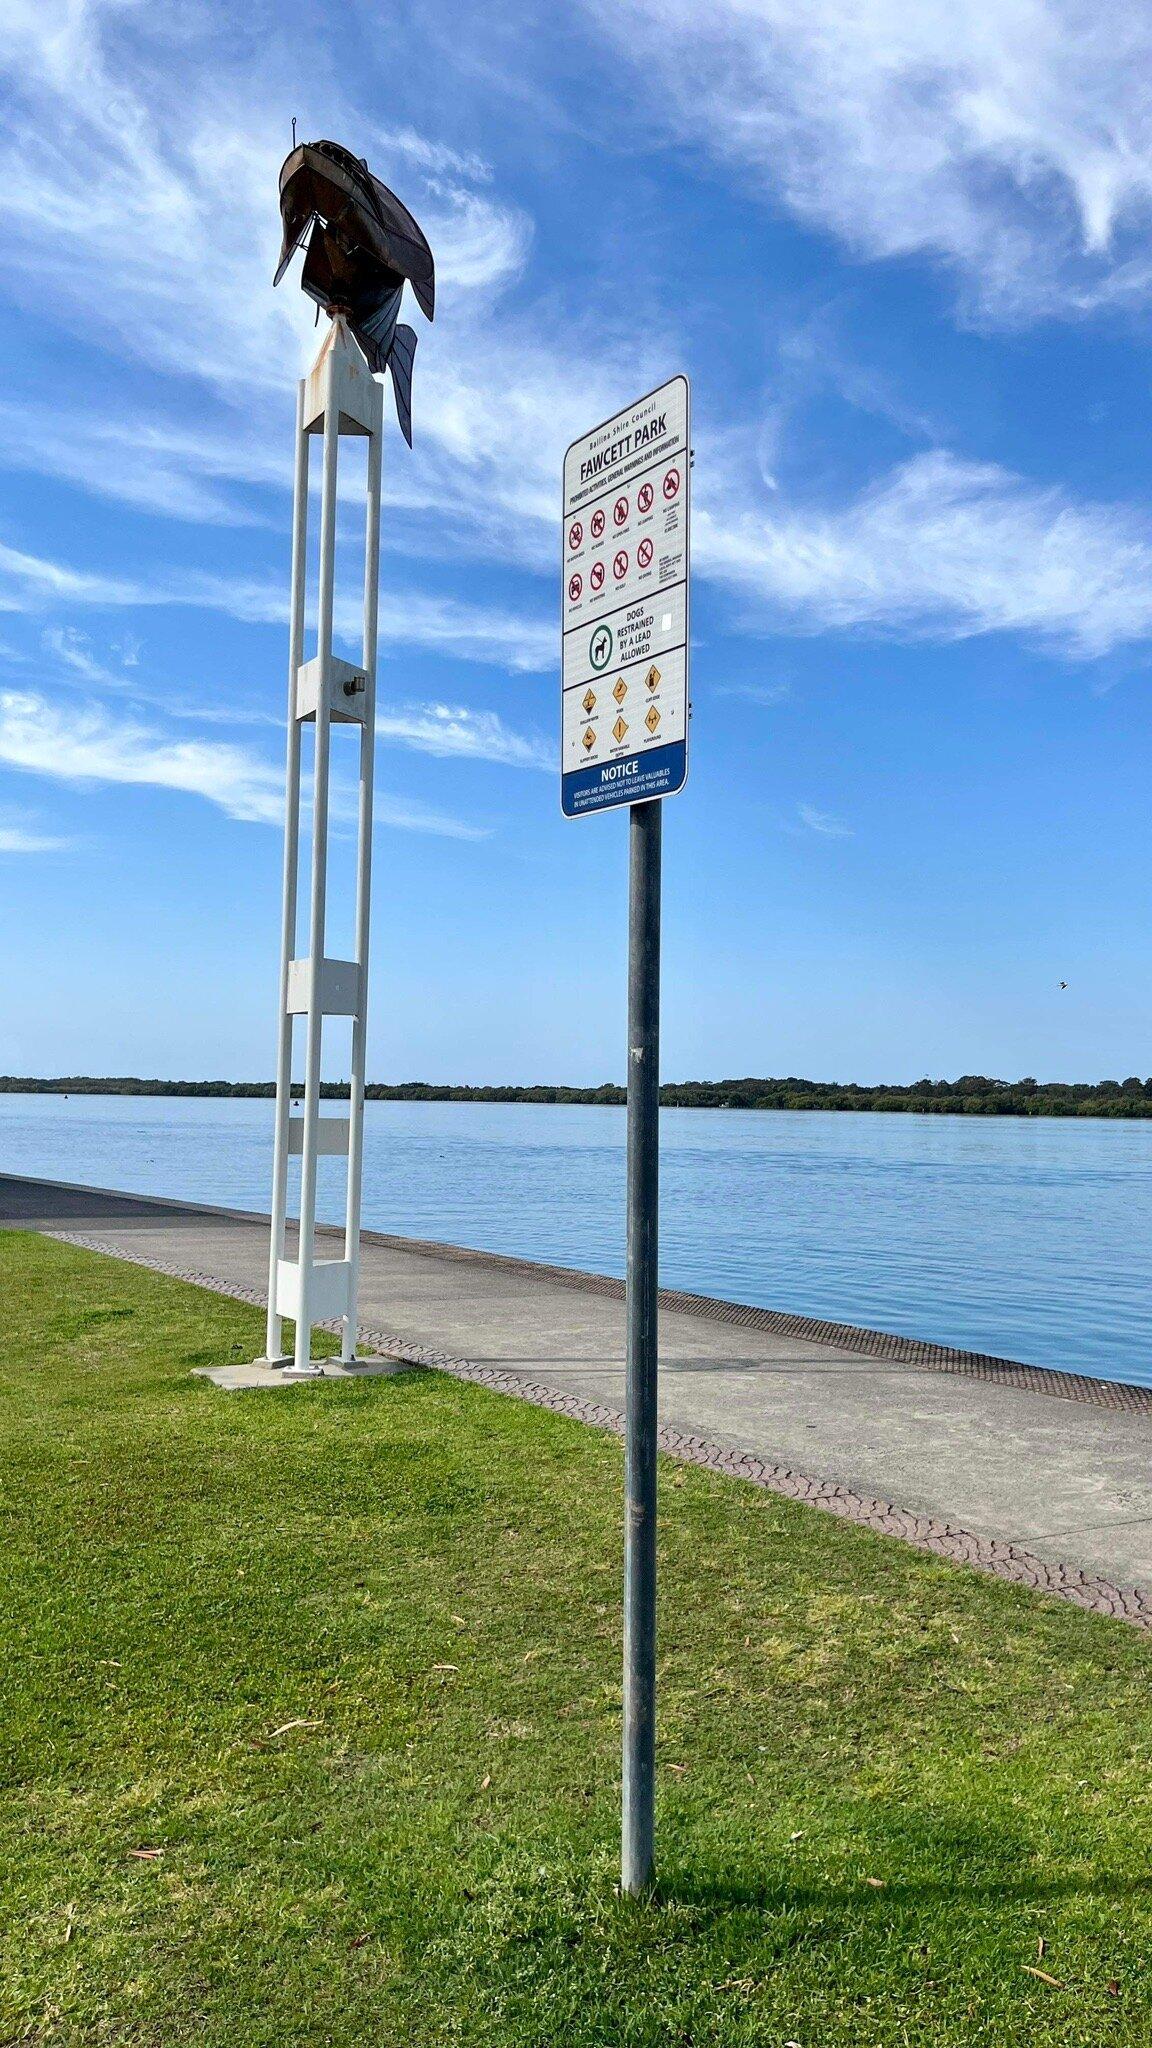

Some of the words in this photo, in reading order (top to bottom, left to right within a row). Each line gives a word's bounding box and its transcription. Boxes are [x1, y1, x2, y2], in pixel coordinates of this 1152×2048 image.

[589, 433, 611, 450] Ballina
[612, 421, 629, 436] Shire
[631, 401, 656, 423] Council
[581, 434, 632, 481] FAWCETT
[634, 412, 667, 448] PARK
[607, 467, 624, 483] GENERAL
[643, 450, 653, 462] AND
[652, 435, 680, 457] INFORMATION
[626, 606, 644, 622] DOGS
[617, 615, 654, 638] RESTRAINED
[619, 638, 628, 650] BY
[629, 636, 634, 646] A
[635, 630, 651, 644] LEAD
[620, 643, 650, 662] ALLOWED
[601, 760, 639, 782] NOTICE
[573, 788, 591, 799] VISITORS
[590, 786, 599, 795] ARE
[598, 781, 617, 792] ADVISED
[616, 779, 626, 788] NOT
[631, 774, 646, 784] LEAVE
[645, 768, 671, 780] VALUABLES
[578, 796, 605, 807] UNATTENDED
[604, 790, 624, 800] VEHICLES
[623, 785, 641, 795] PARKED
[645, 781, 656, 790] THIS
